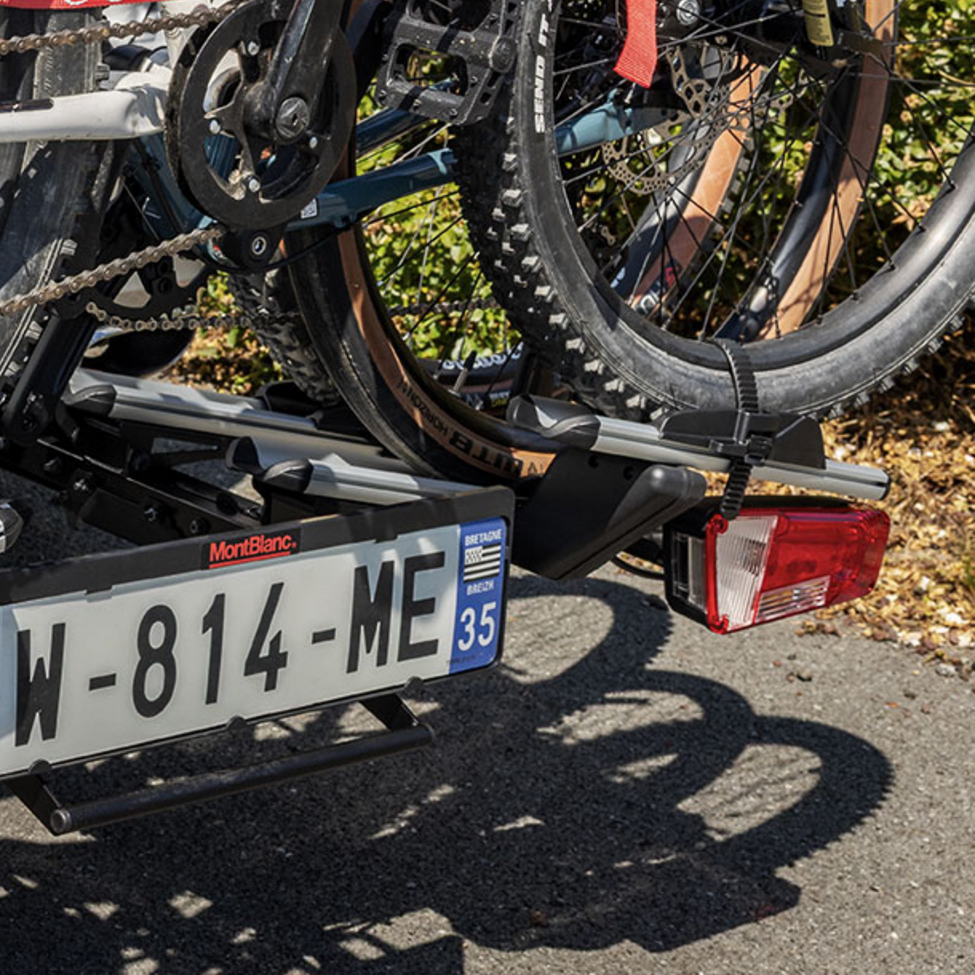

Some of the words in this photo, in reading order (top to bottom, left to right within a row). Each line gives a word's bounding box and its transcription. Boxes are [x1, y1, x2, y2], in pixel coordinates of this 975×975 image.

[538, 13, 550, 47] IT
[534, 55, 546, 134] SEND
[209, 534, 292, 562] MontBlanc
[464, 528, 503, 547] BRETAGNE
[466, 581, 495, 596] BREIZH
[457, 601, 497, 651] 35
[14, 550, 446, 748] W-814-ME
